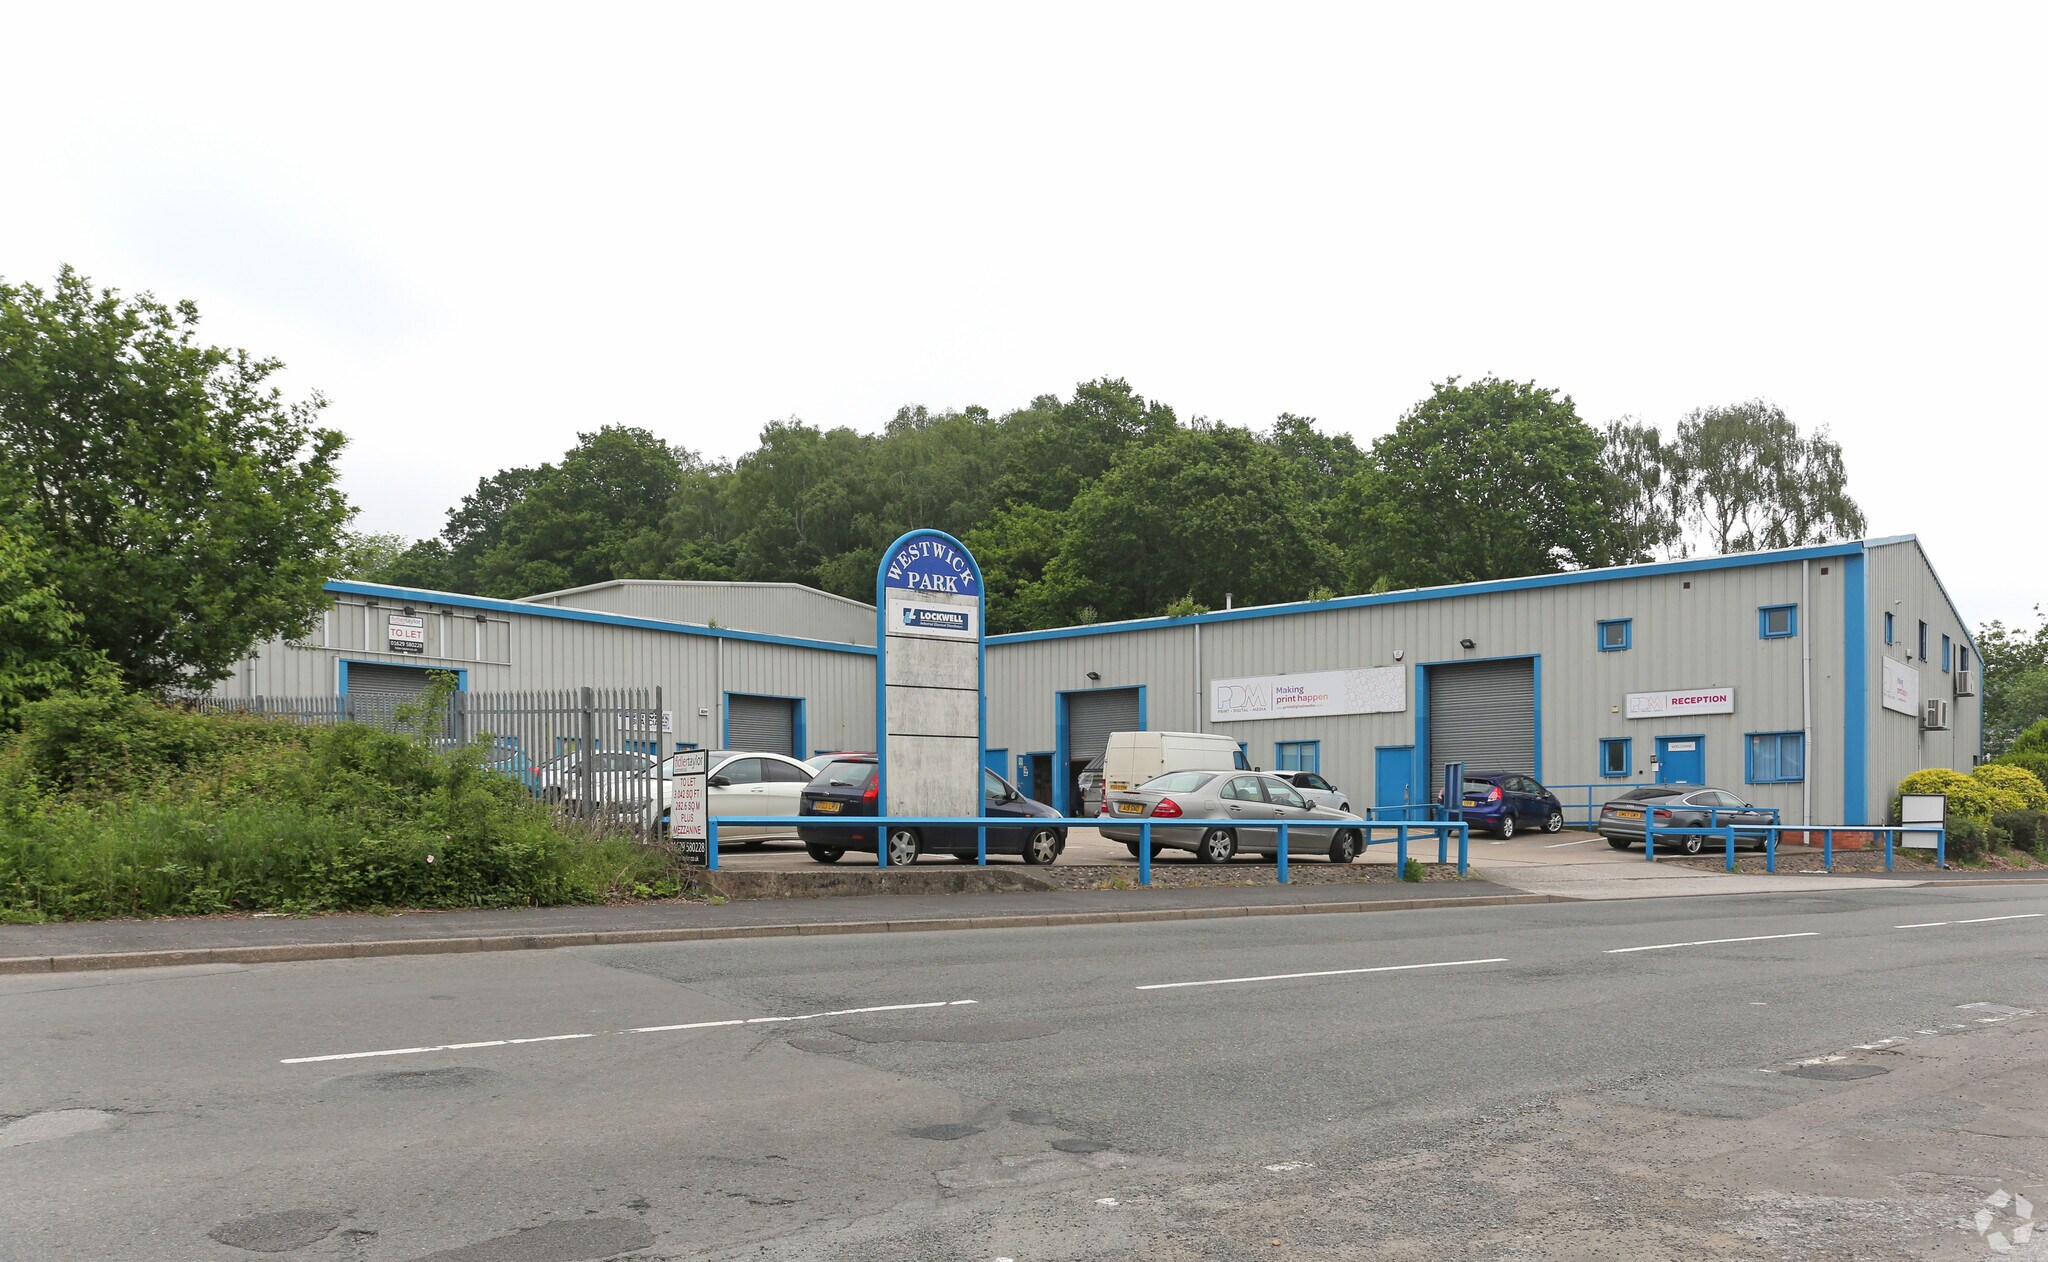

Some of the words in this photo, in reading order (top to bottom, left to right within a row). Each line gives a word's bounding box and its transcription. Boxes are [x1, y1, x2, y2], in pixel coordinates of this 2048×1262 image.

[887, 541, 975, 588] WESTWICK
[907, 571, 958, 593] PARK
[920, 611, 963, 623] LOCKWELL
[390, 629, 403, 637] TO
[405, 630, 422, 639] LET
[1276, 685, 1304, 694] Making
[1217, 683, 1267, 709] PDM
[1276, 695, 1296, 704] print
[1297, 693, 1328, 703] happen
[1671, 695, 1727, 705] RECEPTION
[680, 778, 686, 786] TO
[687, 777, 696, 786] LET
[686, 790, 693, 800] SQ
[694, 789, 700, 798] FT
[688, 801, 695, 812] SQ
[695, 801, 700, 810] M
[681, 814, 694, 822] PLUS
[673, 825, 701, 834] MEZZANINE
[686, 842, 705, 853] 580228
